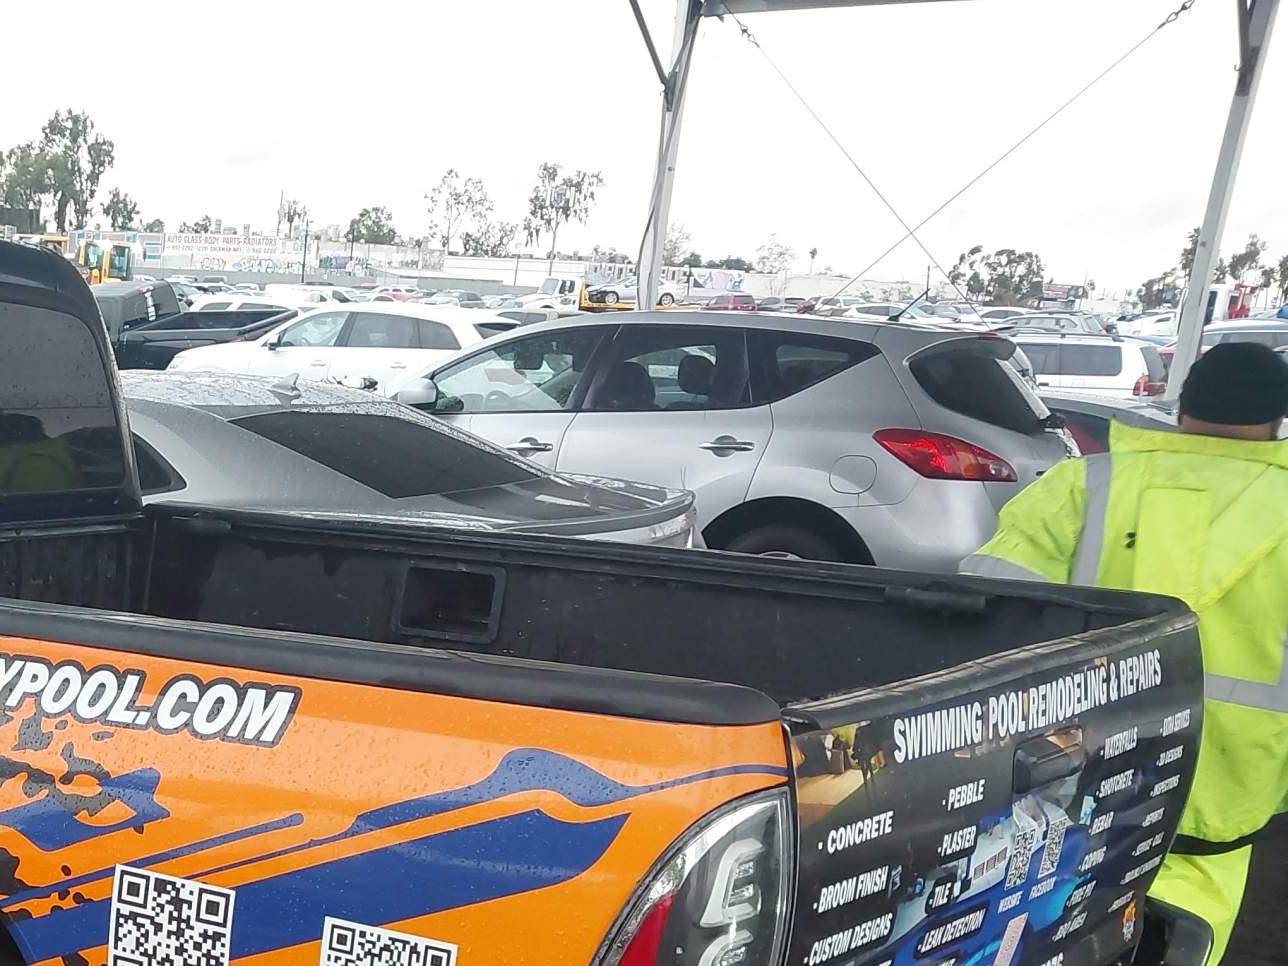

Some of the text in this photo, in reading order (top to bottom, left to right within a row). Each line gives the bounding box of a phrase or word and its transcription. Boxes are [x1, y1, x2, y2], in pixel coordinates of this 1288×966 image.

[893, 649, 1162, 764] SWIMMING POOL REMODELING & REPAIRS
[947, 778, 985, 811] PEBBLE
[827, 810, 894, 855] CONCRETE
[940, 825, 977, 857] PLASTER
[817, 864, 889, 914] BROOM FINISH
[931, 880, 951, 909] TILE
[808, 912, 893, 966] CUSTOM DESIGNS
[921, 907, 987, 953] LEAK DETECTION
